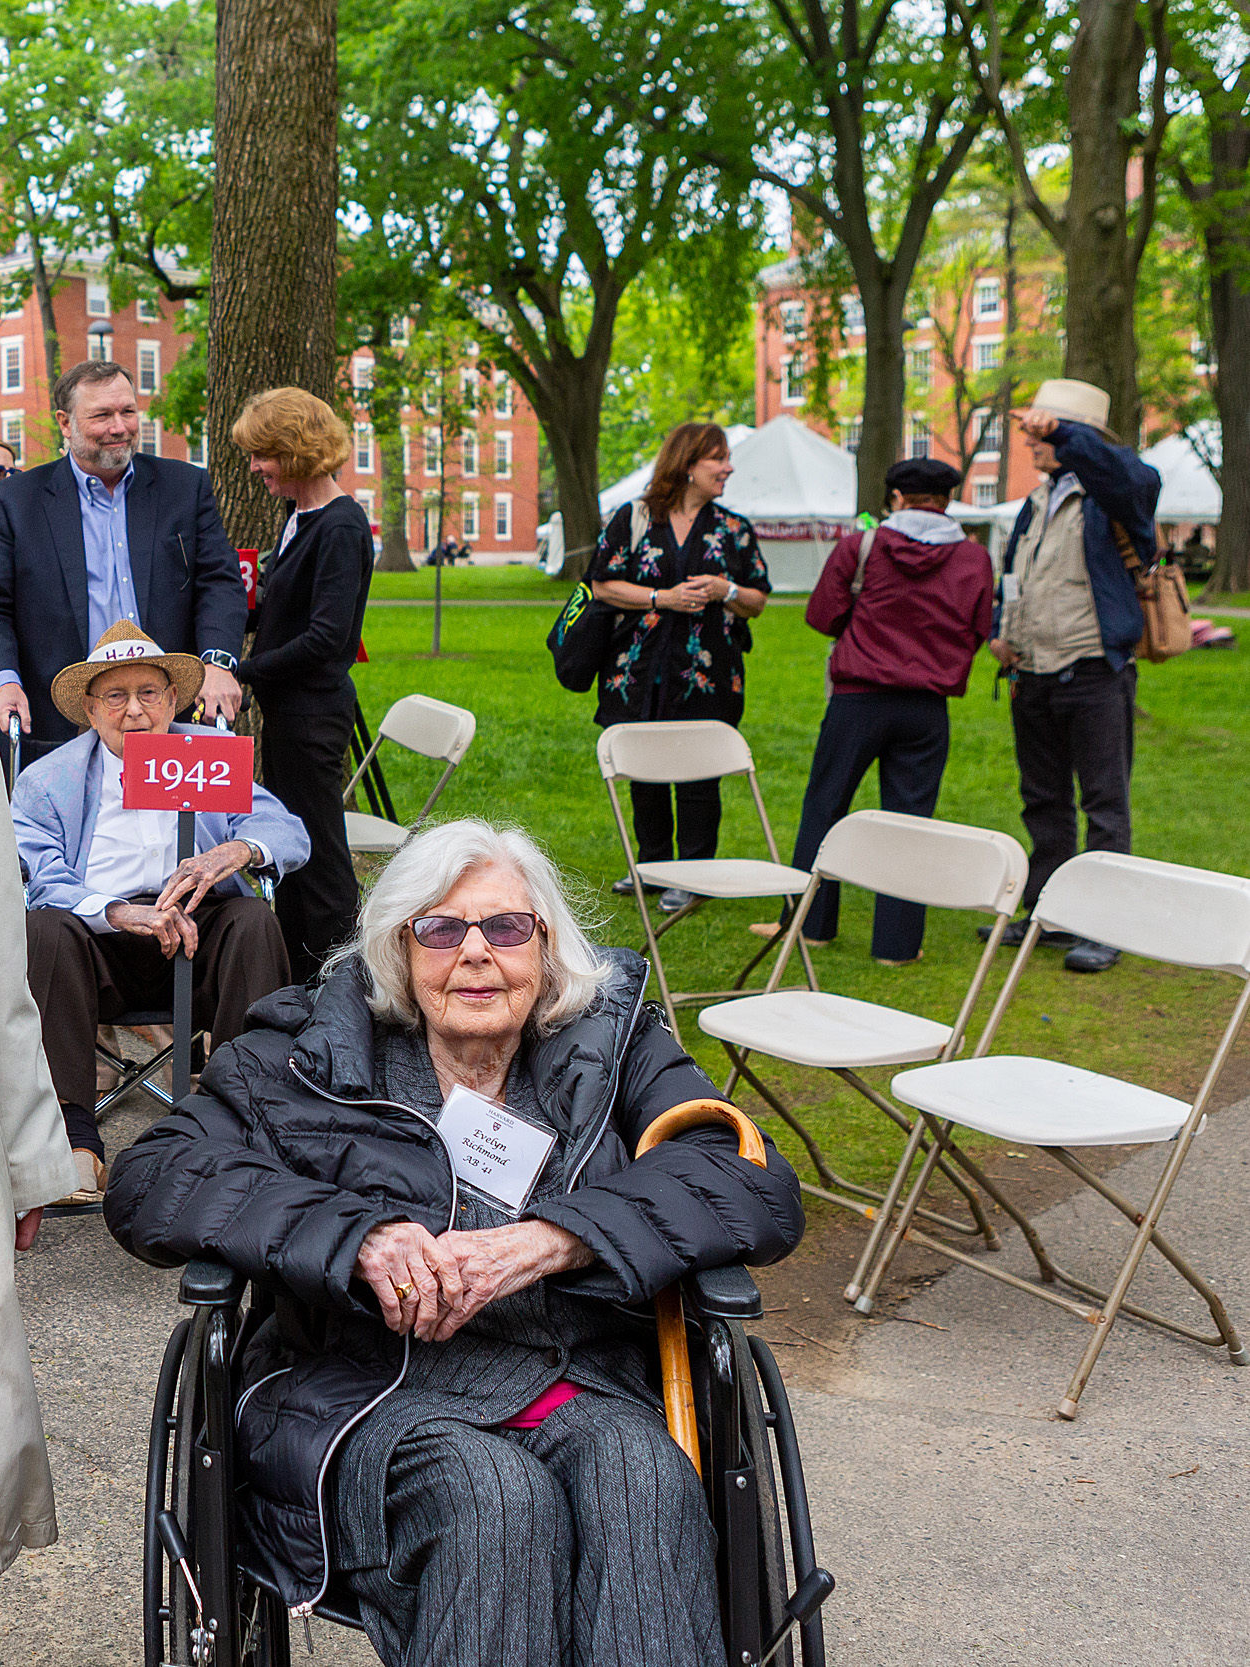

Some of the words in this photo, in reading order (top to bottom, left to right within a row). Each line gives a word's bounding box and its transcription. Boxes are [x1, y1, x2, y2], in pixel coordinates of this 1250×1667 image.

[105, 646, 146, 660] H-42
[143, 758, 231, 792] 1942
[488, 1109, 514, 1126] HARVARD
[472, 1128, 507, 1152] Evelyn
[462, 1137, 511, 1167] Richmond
[462, 1155, 480, 1167] AB
